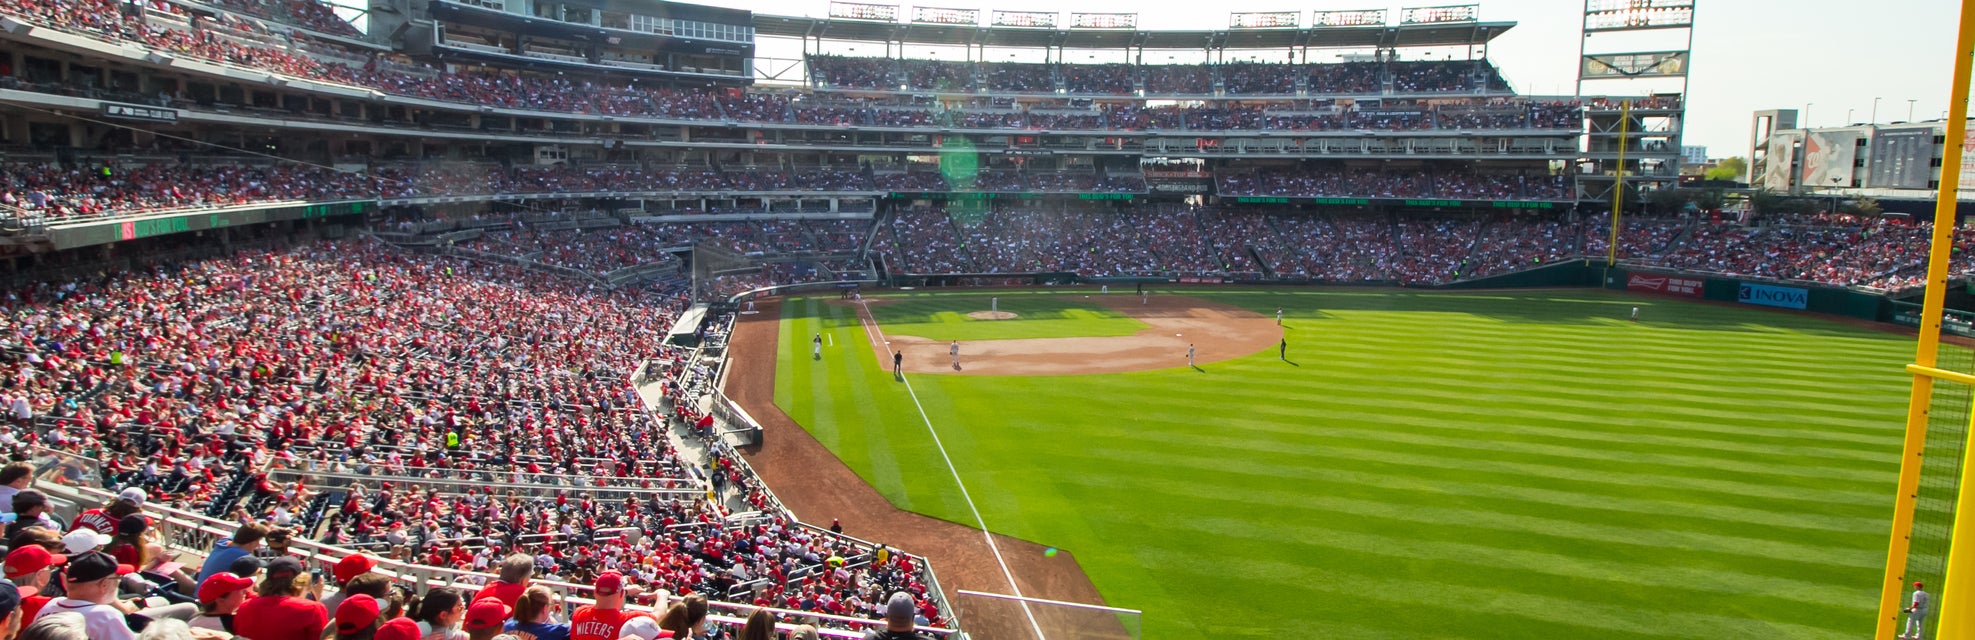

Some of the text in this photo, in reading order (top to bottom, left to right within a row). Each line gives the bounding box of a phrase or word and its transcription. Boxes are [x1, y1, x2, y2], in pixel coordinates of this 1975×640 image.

[1755, 285, 1805, 304] INOVA
[79, 512, 114, 534] TURNER
[576, 621, 614, 639] WIETERS
